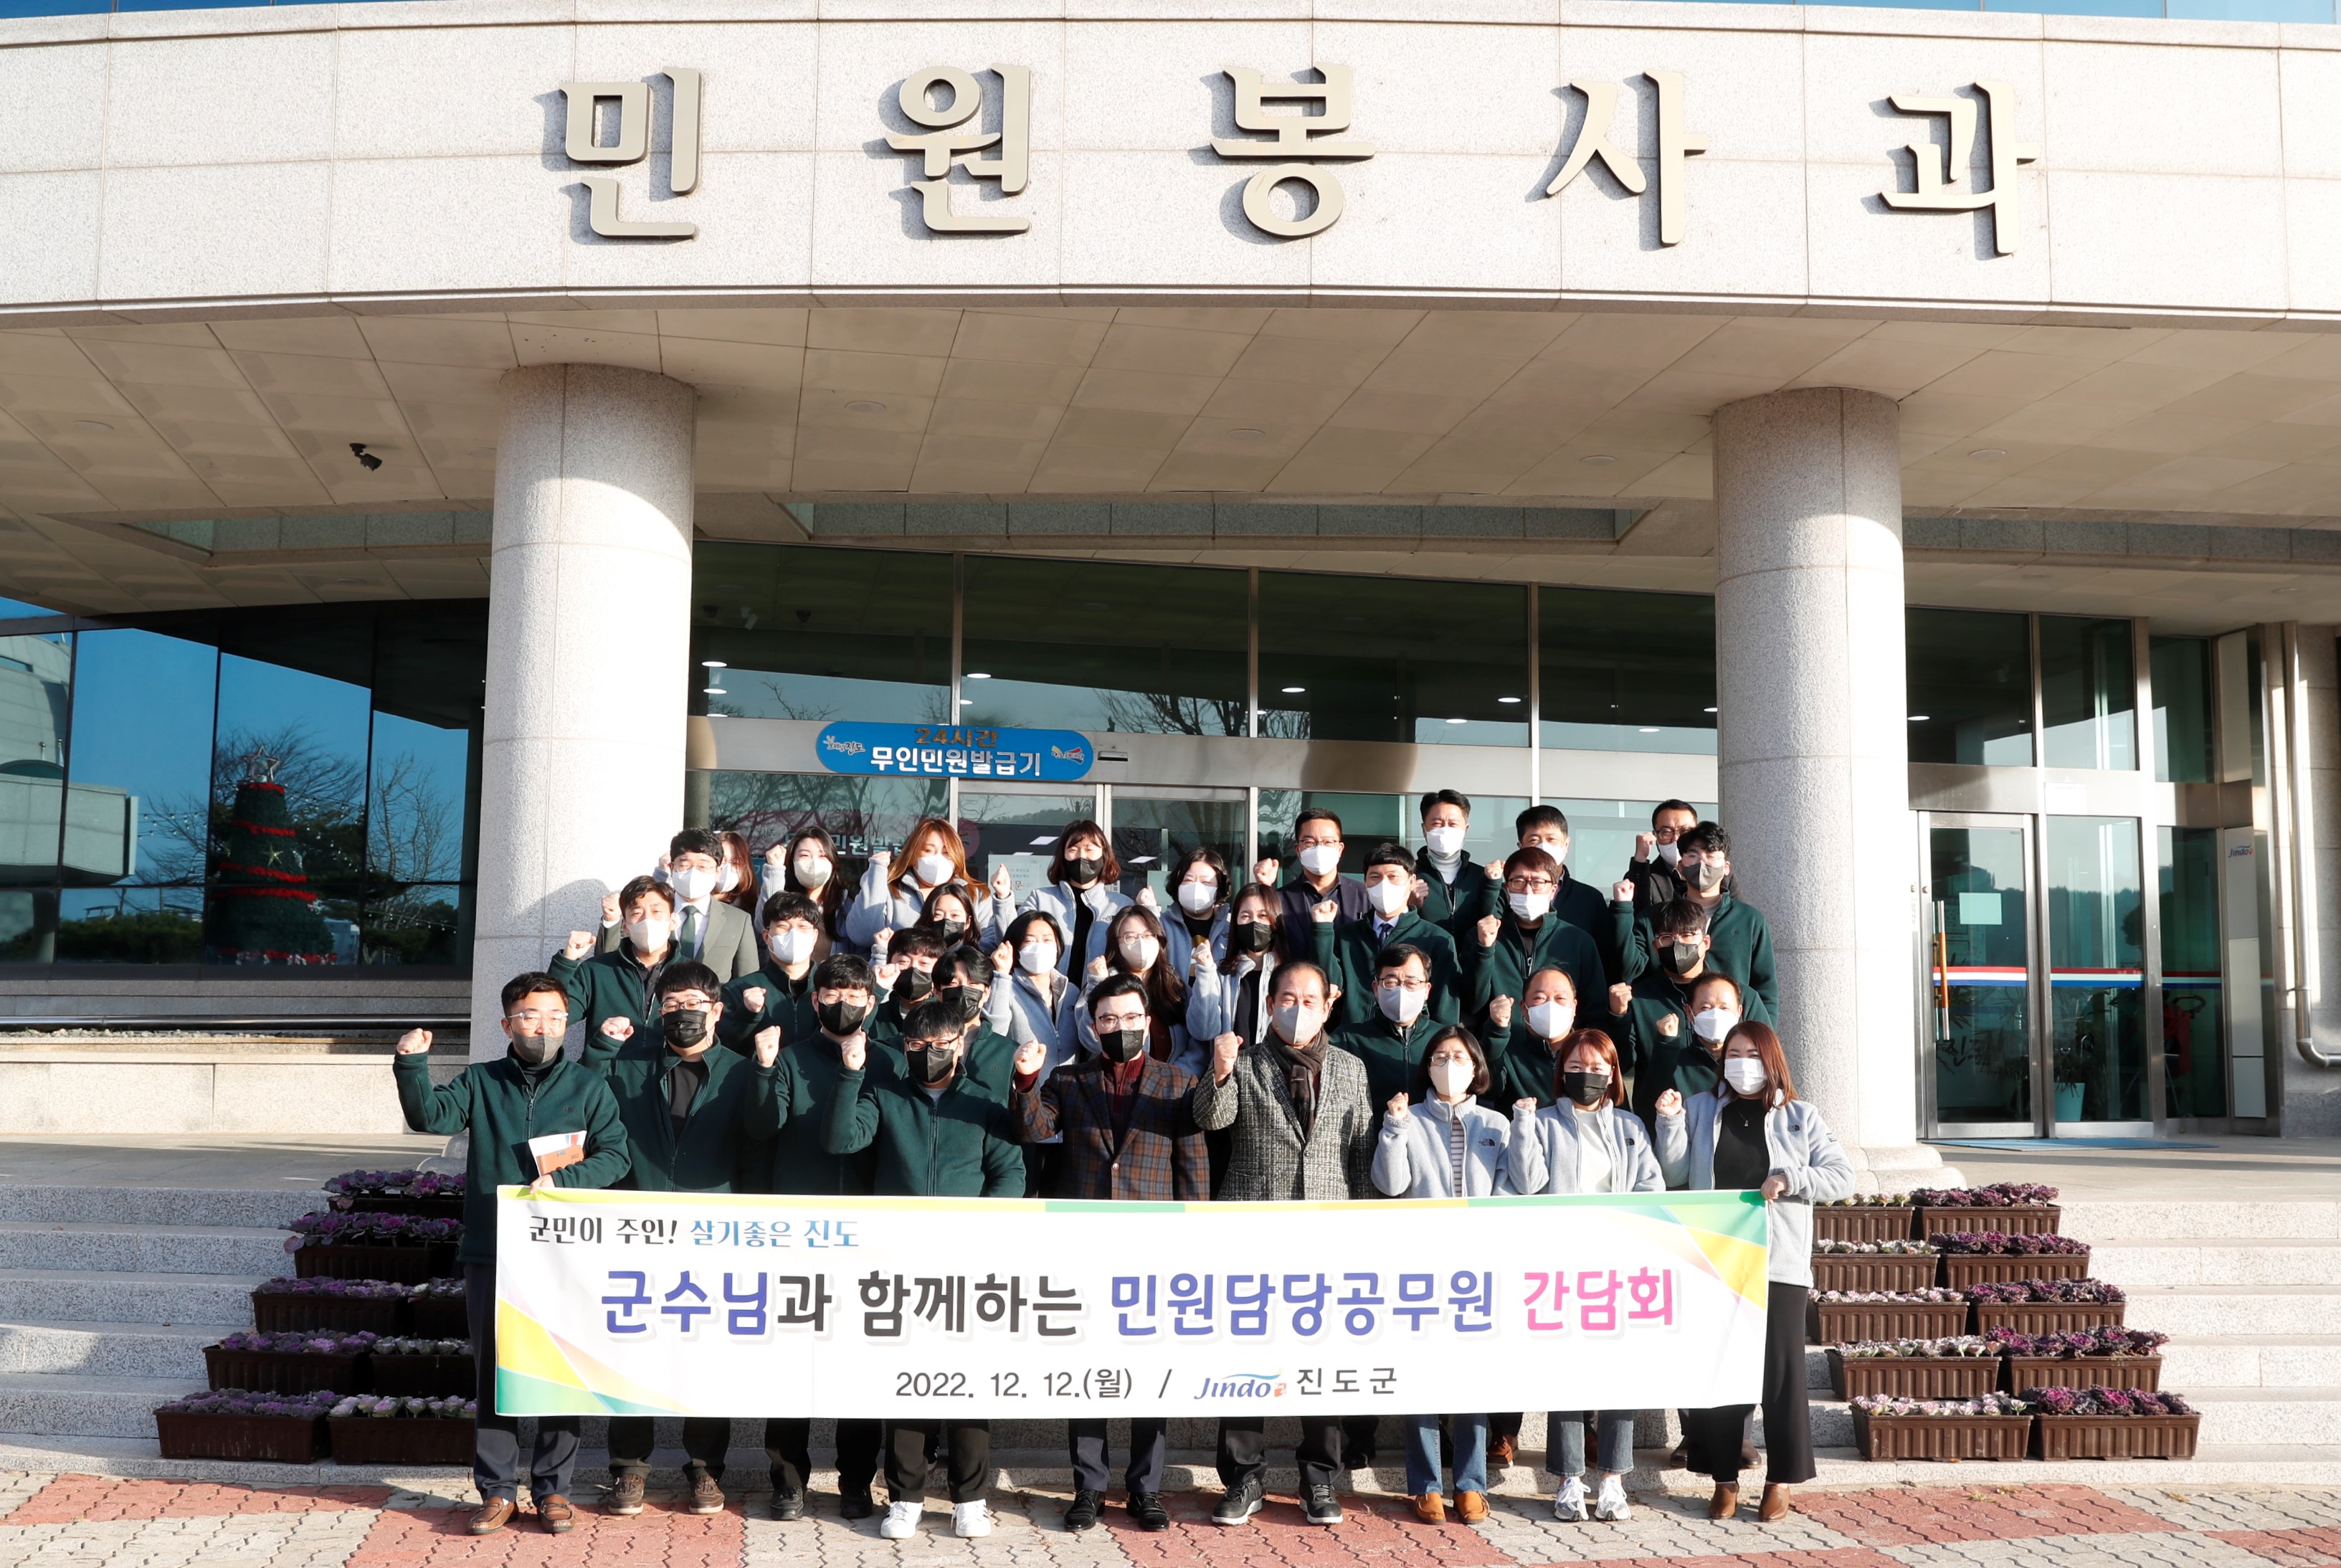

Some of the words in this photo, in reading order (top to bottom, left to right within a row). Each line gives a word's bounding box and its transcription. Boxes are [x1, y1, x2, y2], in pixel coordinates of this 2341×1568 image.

[559, 65, 2041, 257] 민원봉사과
[914, 726, 999, 749] 24시간
[870, 746, 1041, 777] 무인민원발급기
[529, 1215, 603, 1245] 군민이
[616, 1218, 678, 1245] 주인!
[690, 1220, 792, 1248] 살기좋은
[804, 1220, 860, 1249] 진도
[601, 1270, 832, 1336] 군수님과
[859, 1271, 1083, 1338] 함께하는
[1111, 1271, 1494, 1337] 민원담당공무원
[1524, 1266, 1673, 1331] 간담회
[896, 1372, 974, 1399] 2022.
[991, 1372, 1028, 1399] 12.
[1194, 1377, 1272, 1400] Jindo
[1296, 1367, 1397, 1396] 진도군
